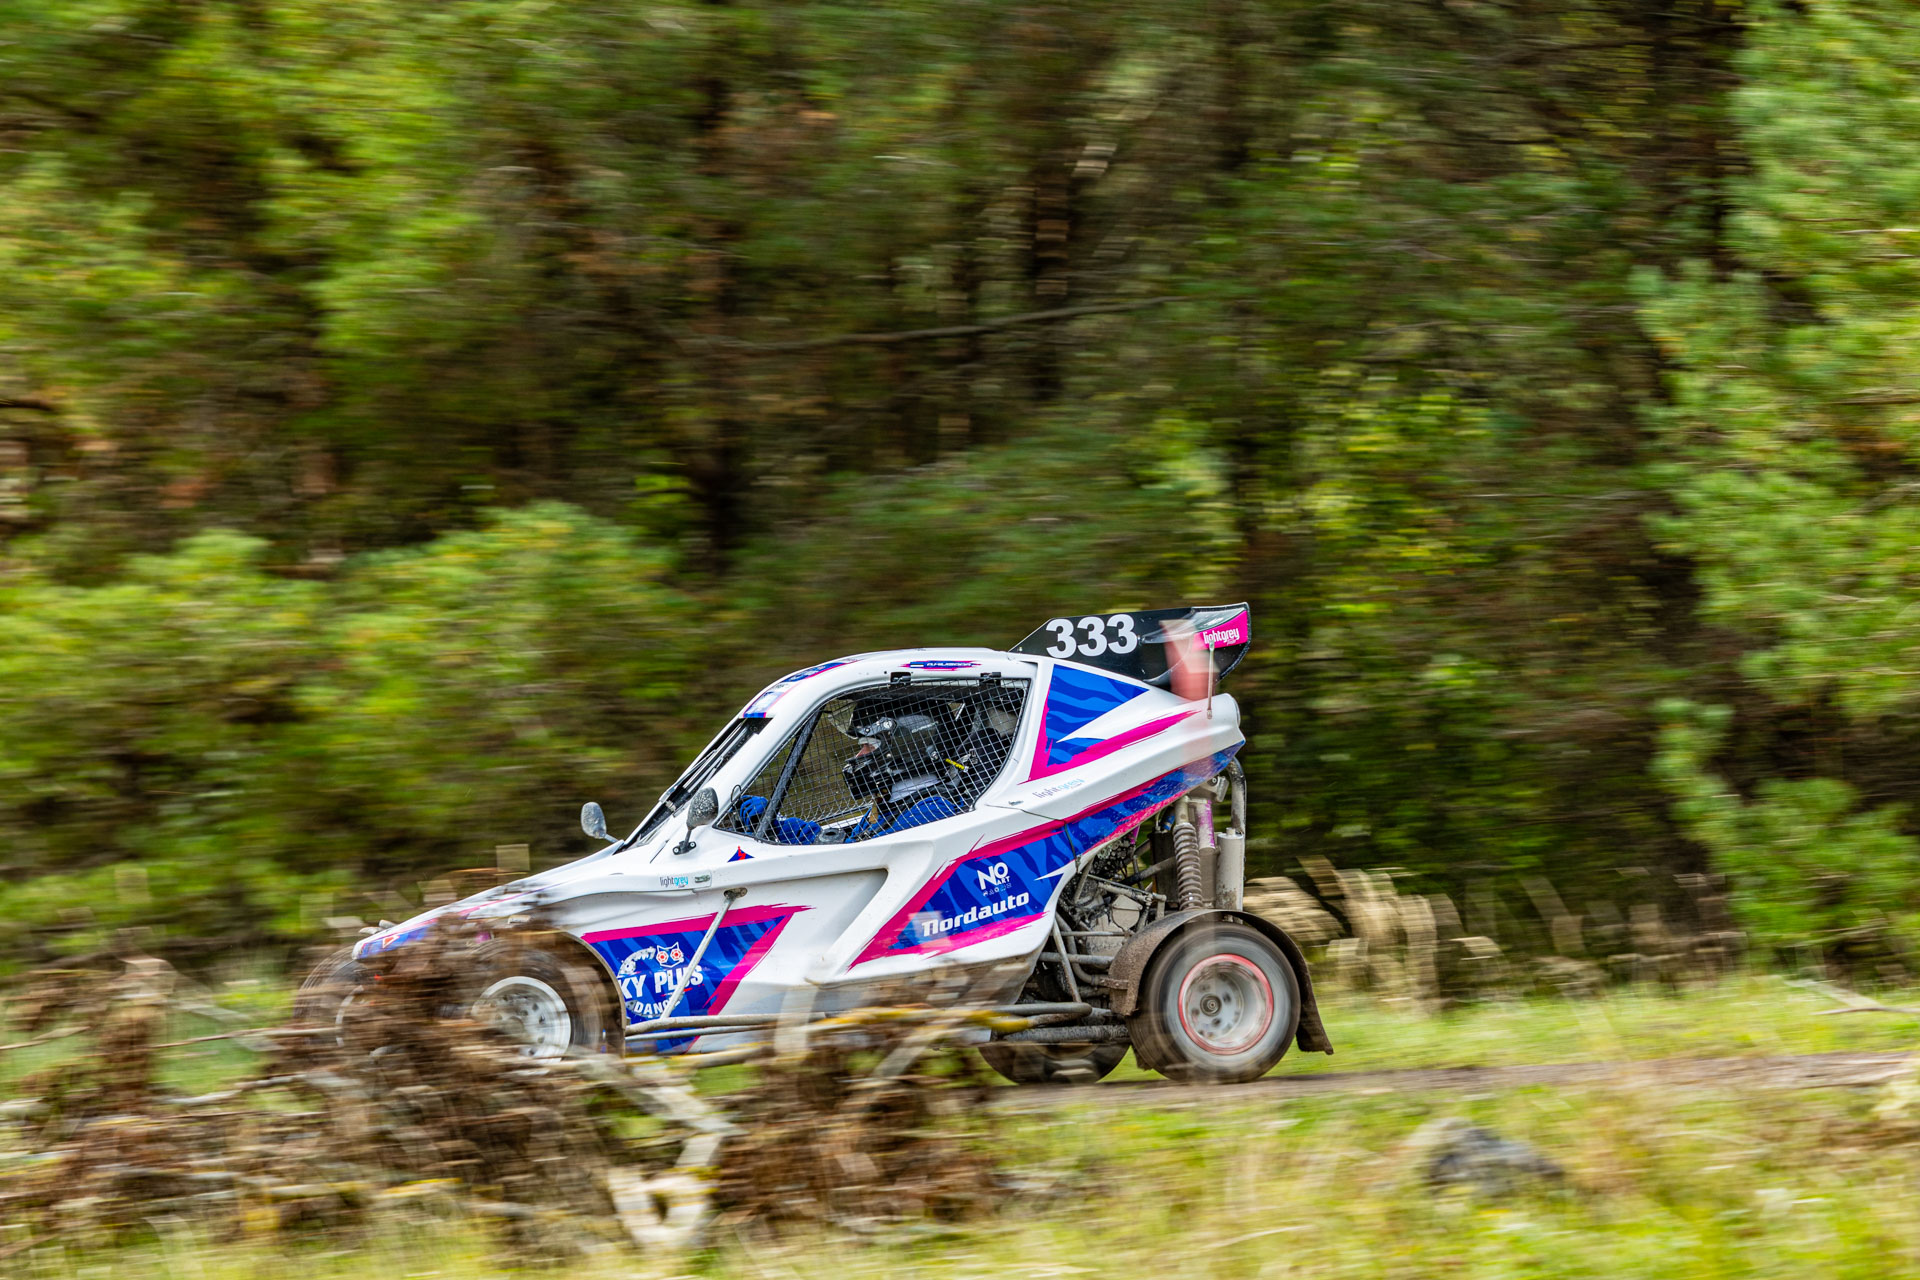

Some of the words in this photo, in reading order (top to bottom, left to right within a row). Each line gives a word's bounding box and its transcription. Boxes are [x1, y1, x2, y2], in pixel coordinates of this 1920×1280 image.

[1046, 613, 1138, 659] 333
[659, 875, 689, 888] lightgrey
[976, 862, 1008, 890] NO
[618, 974, 647, 999] KY
[653, 964, 704, 994] PLUS
